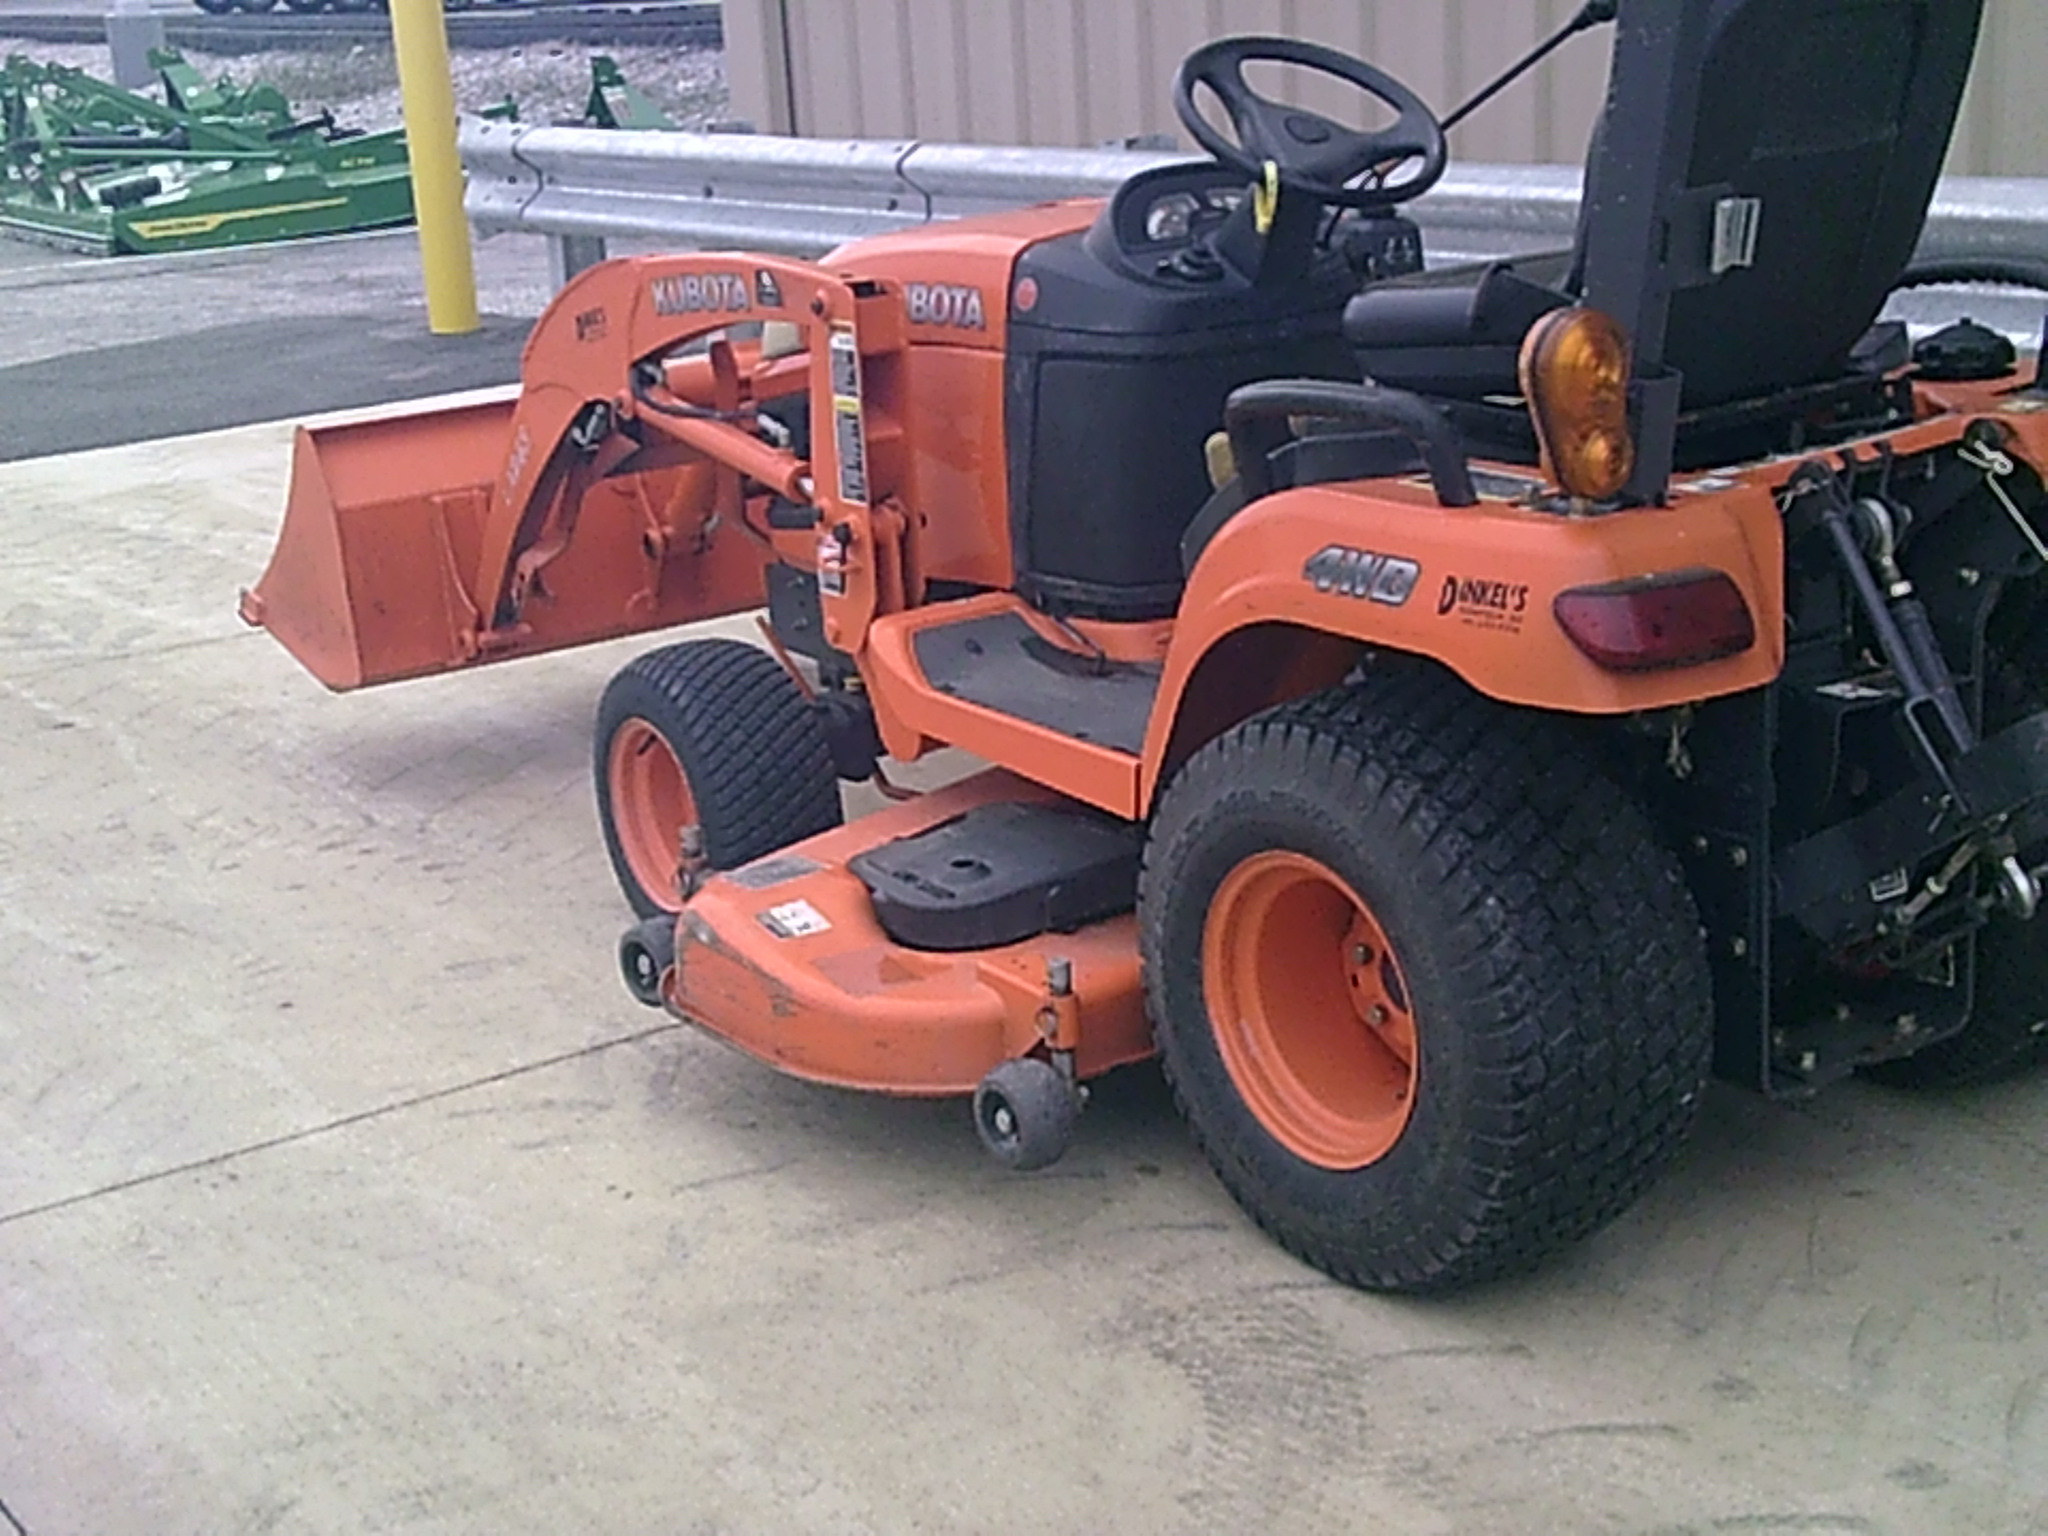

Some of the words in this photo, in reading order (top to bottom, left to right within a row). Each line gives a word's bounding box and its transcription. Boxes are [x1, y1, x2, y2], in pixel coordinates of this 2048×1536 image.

[651, 273, 751, 315] KUBOTA
[907, 282, 985, 331] BOTA
[1303, 543, 1421, 606] 4WD
[1437, 575, 1529, 615] DINKEL'S
